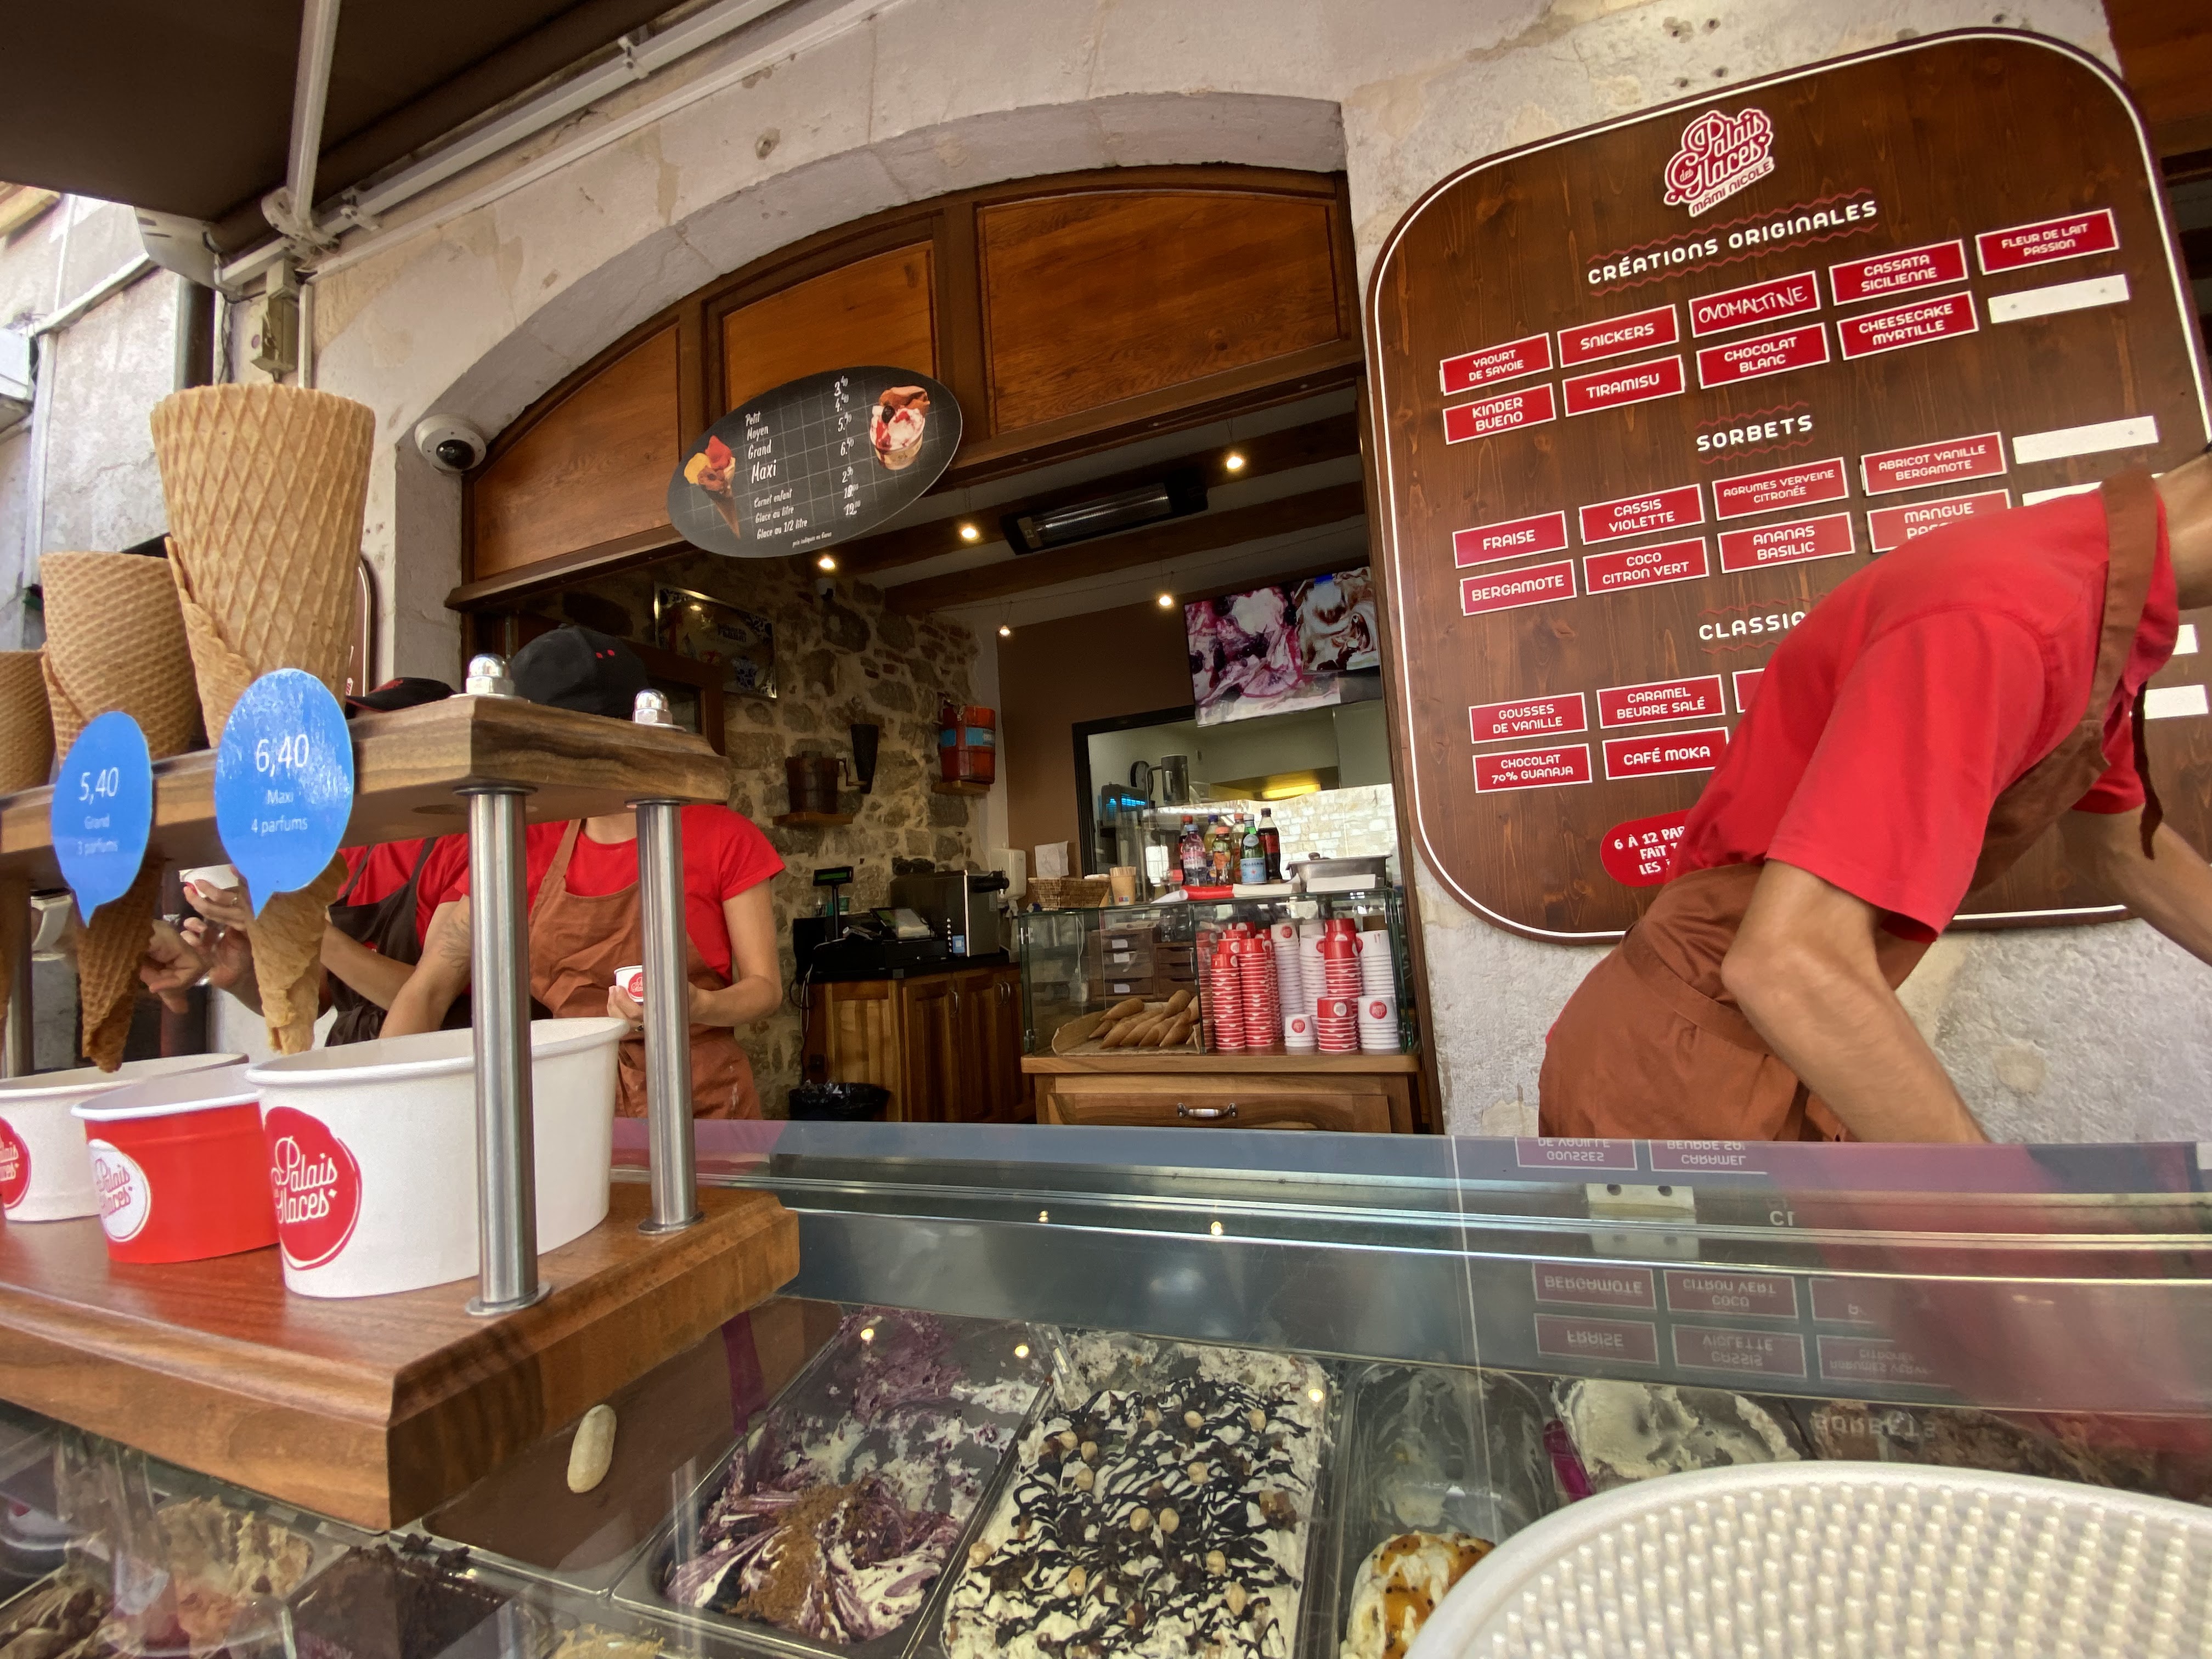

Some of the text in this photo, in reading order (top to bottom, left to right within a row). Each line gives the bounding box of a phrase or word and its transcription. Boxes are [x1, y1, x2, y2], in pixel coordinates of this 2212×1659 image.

[1686, 113, 1765, 159] Palais
[1672, 139, 1763, 198] Glaces
[1680, 168, 1693, 182] des
[1729, 162, 1771, 193] NICOLE
[1588, 200, 1877, 284] CRÉATIONS ORIGINALES
[2001, 223, 2088, 249] FLEUR DE LAIT
[2023, 238, 2076, 257] PASSION
[1864, 254, 1930, 276] CASSATA
[1861, 267, 1937, 292] SICILIENNE
[1699, 286, 1808, 323] OVOMALTINE
[1859, 303, 1954, 335] CHEESECAKE
[1580, 323, 1655, 351] SNICKERS
[1873, 319, 1945, 347] MYRTILLE
[1473, 349, 1516, 368] YAOURT
[1724, 336, 1797, 363] CHOCOLAT
[1469, 359, 1524, 381] DE SAVOIE
[1739, 354, 1786, 374] BLANC
[1586, 373, 1660, 398] TIRAMISU
[1472, 397, 1523, 418] KINDER
[745, 411, 761, 427] Petit
[1476, 412, 1523, 432] BUENO
[747, 426, 769, 442] Moyen
[1697, 414, 1813, 452] SORBETS
[748, 438, 772, 460] Grand
[1878, 444, 1986, 471] ABRICOT VANILLE
[752, 459, 777, 484] Maxi
[1895, 460, 1972, 481] BERGAMOTE
[1723, 469, 1835, 498] AGRUMES VERVEINE
[754, 494, 772, 508] Cornet
[774, 488, 793, 502] enfant
[1753, 485, 1807, 504] CITRONÉE
[755, 512, 771, 523] Glace
[773, 510, 780, 518] au
[782, 505, 794, 516] litre
[1614, 499, 1662, 517] CASSIS
[1904, 502, 1974, 523] MANGUE
[757, 528, 773, 539] Glace
[775, 527, 782, 535] au
[783, 520, 794, 532] 1/2
[795, 518, 808, 529] litre
[1608, 511, 1675, 532] VIOLETTE
[1483, 529, 1536, 550] FRAISE
[1753, 525, 1815, 546] ANANAS
[1626, 552, 1662, 567] COCO
[1757, 542, 1815, 561] BASILIC
[1602, 561, 1689, 585] CITRON VERT
[1471, 574, 1565, 602] BERGAMOTE
[1627, 687, 1691, 704] CARAMEL
[1498, 704, 1554, 719] GOUSSES
[1616, 696, 1706, 719] BEURRE SALÉ
[1493, 716, 1563, 734] DE VANILLE
[256, 733, 309, 777] 6,40
[1500, 754, 1561, 769] CHOCOLAT
[1623, 746, 1711, 766] CAFÉ MOKA
[1491, 765, 1573, 785] 70% GUANAJA
[78, 767, 119, 805] 5,40
[267, 789, 294, 804] Maxi
[251, 815, 308, 837] 4 parfums
[1614, 838, 1623, 849] 6
[1628, 834, 1639, 848] À
[1642, 832, 1659, 845] 12
[1639, 861, 1661, 875] LES
[275, 1136, 338, 1192] Palais
